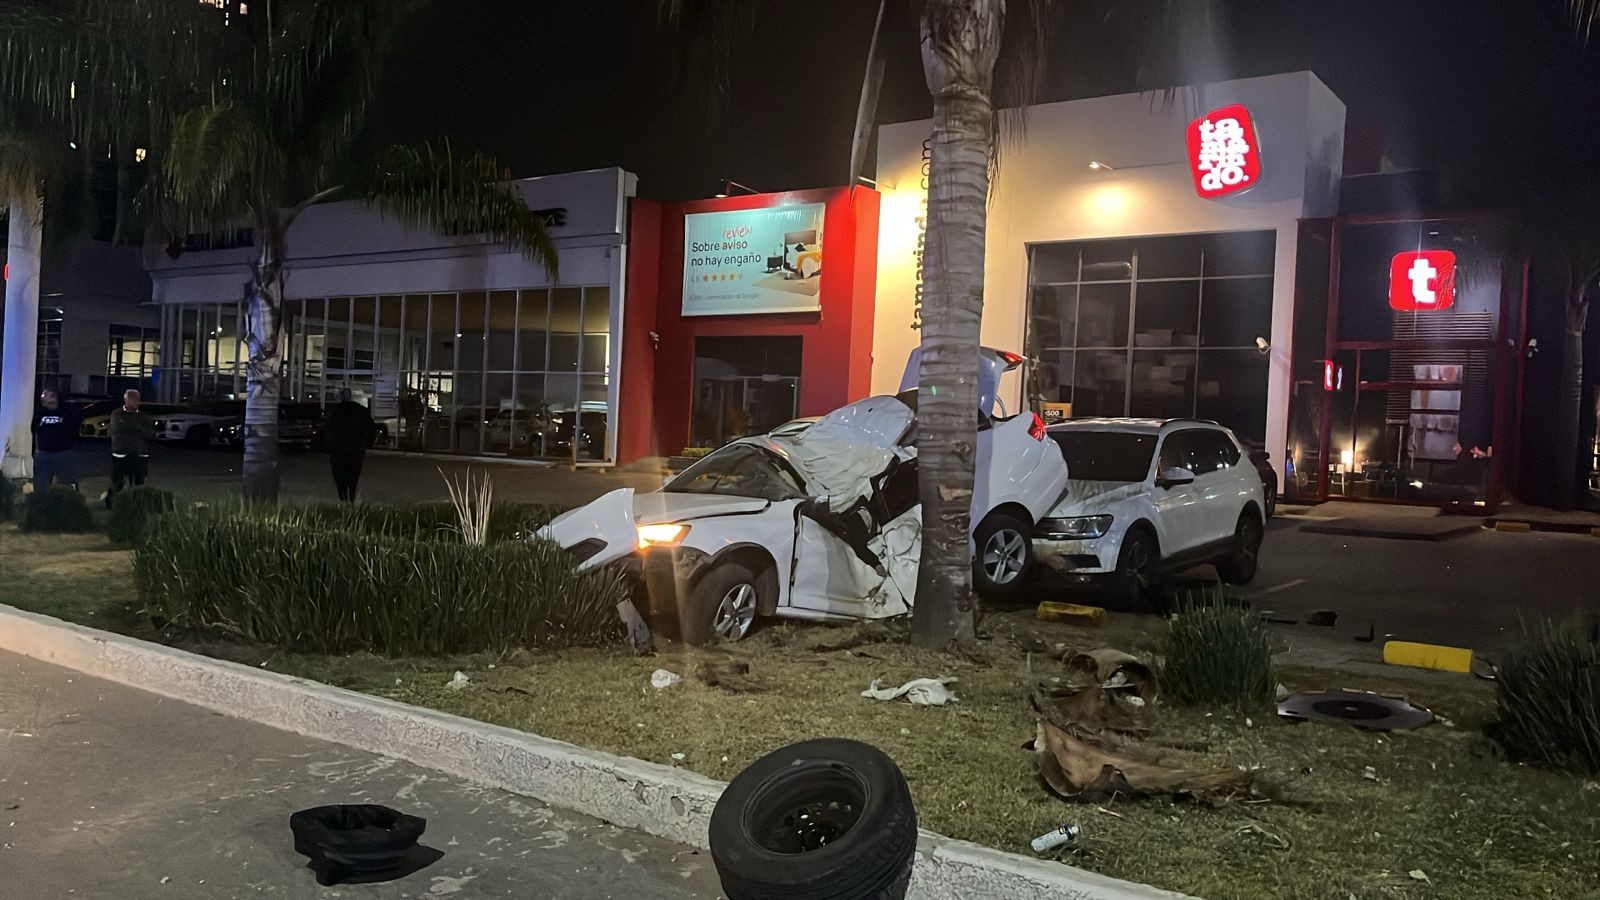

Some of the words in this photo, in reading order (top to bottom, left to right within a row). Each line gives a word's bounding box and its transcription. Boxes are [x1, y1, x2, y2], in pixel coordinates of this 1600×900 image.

[723, 226, 752, 240] review
[692, 241, 720, 253] Sobre
[722, 240, 748, 251] aviso
[691, 258, 703, 267] no
[705, 256, 722, 268] hay
[724, 252, 761, 267] engaño
[1408, 258, 1437, 304] t
